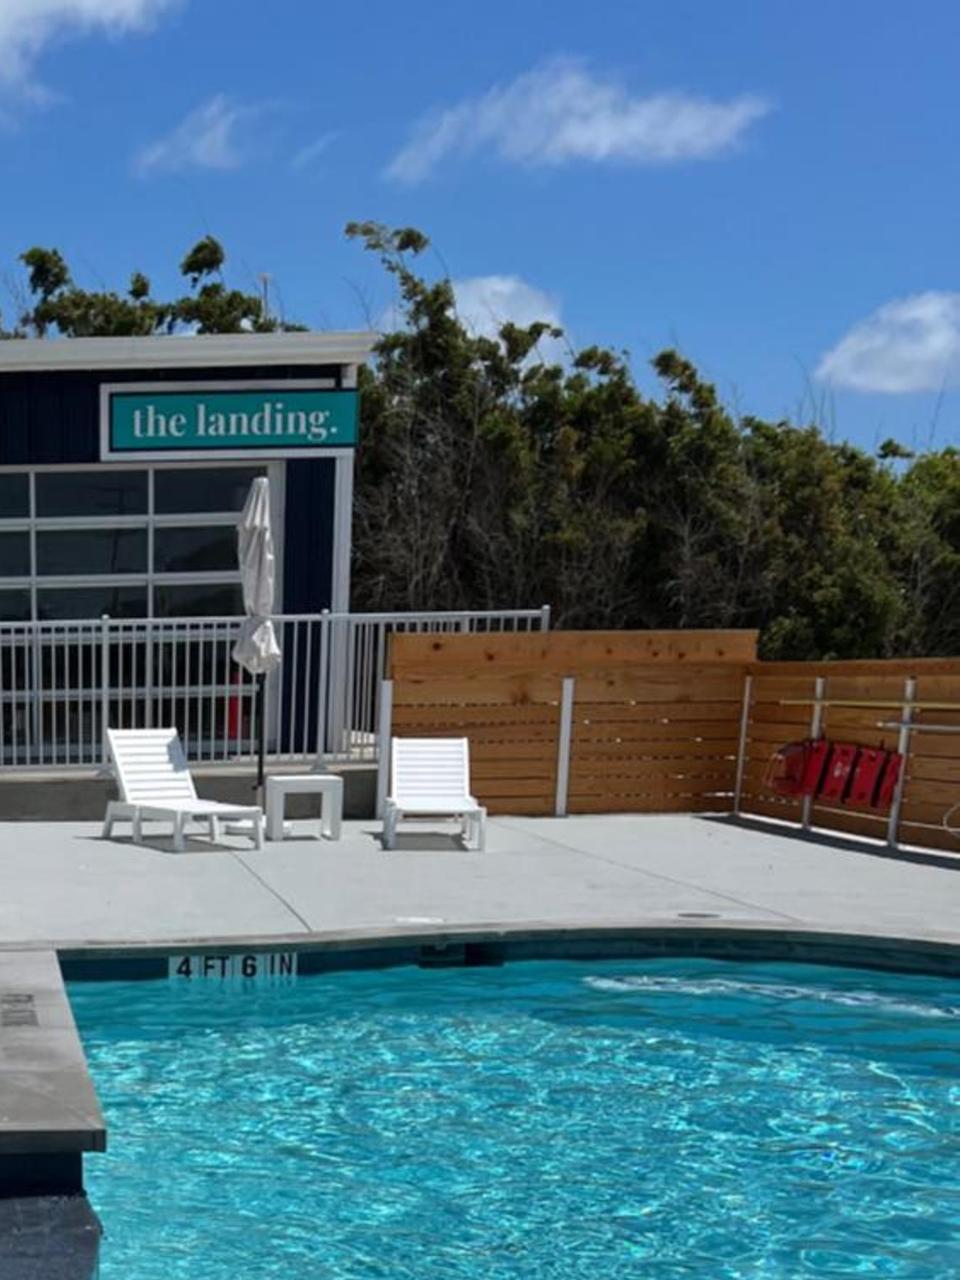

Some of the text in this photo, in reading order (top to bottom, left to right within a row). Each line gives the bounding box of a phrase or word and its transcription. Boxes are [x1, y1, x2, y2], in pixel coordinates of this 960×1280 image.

[133, 402, 338, 442] the landing.
[176, 953, 292, 978] 4 FT 6 IN
